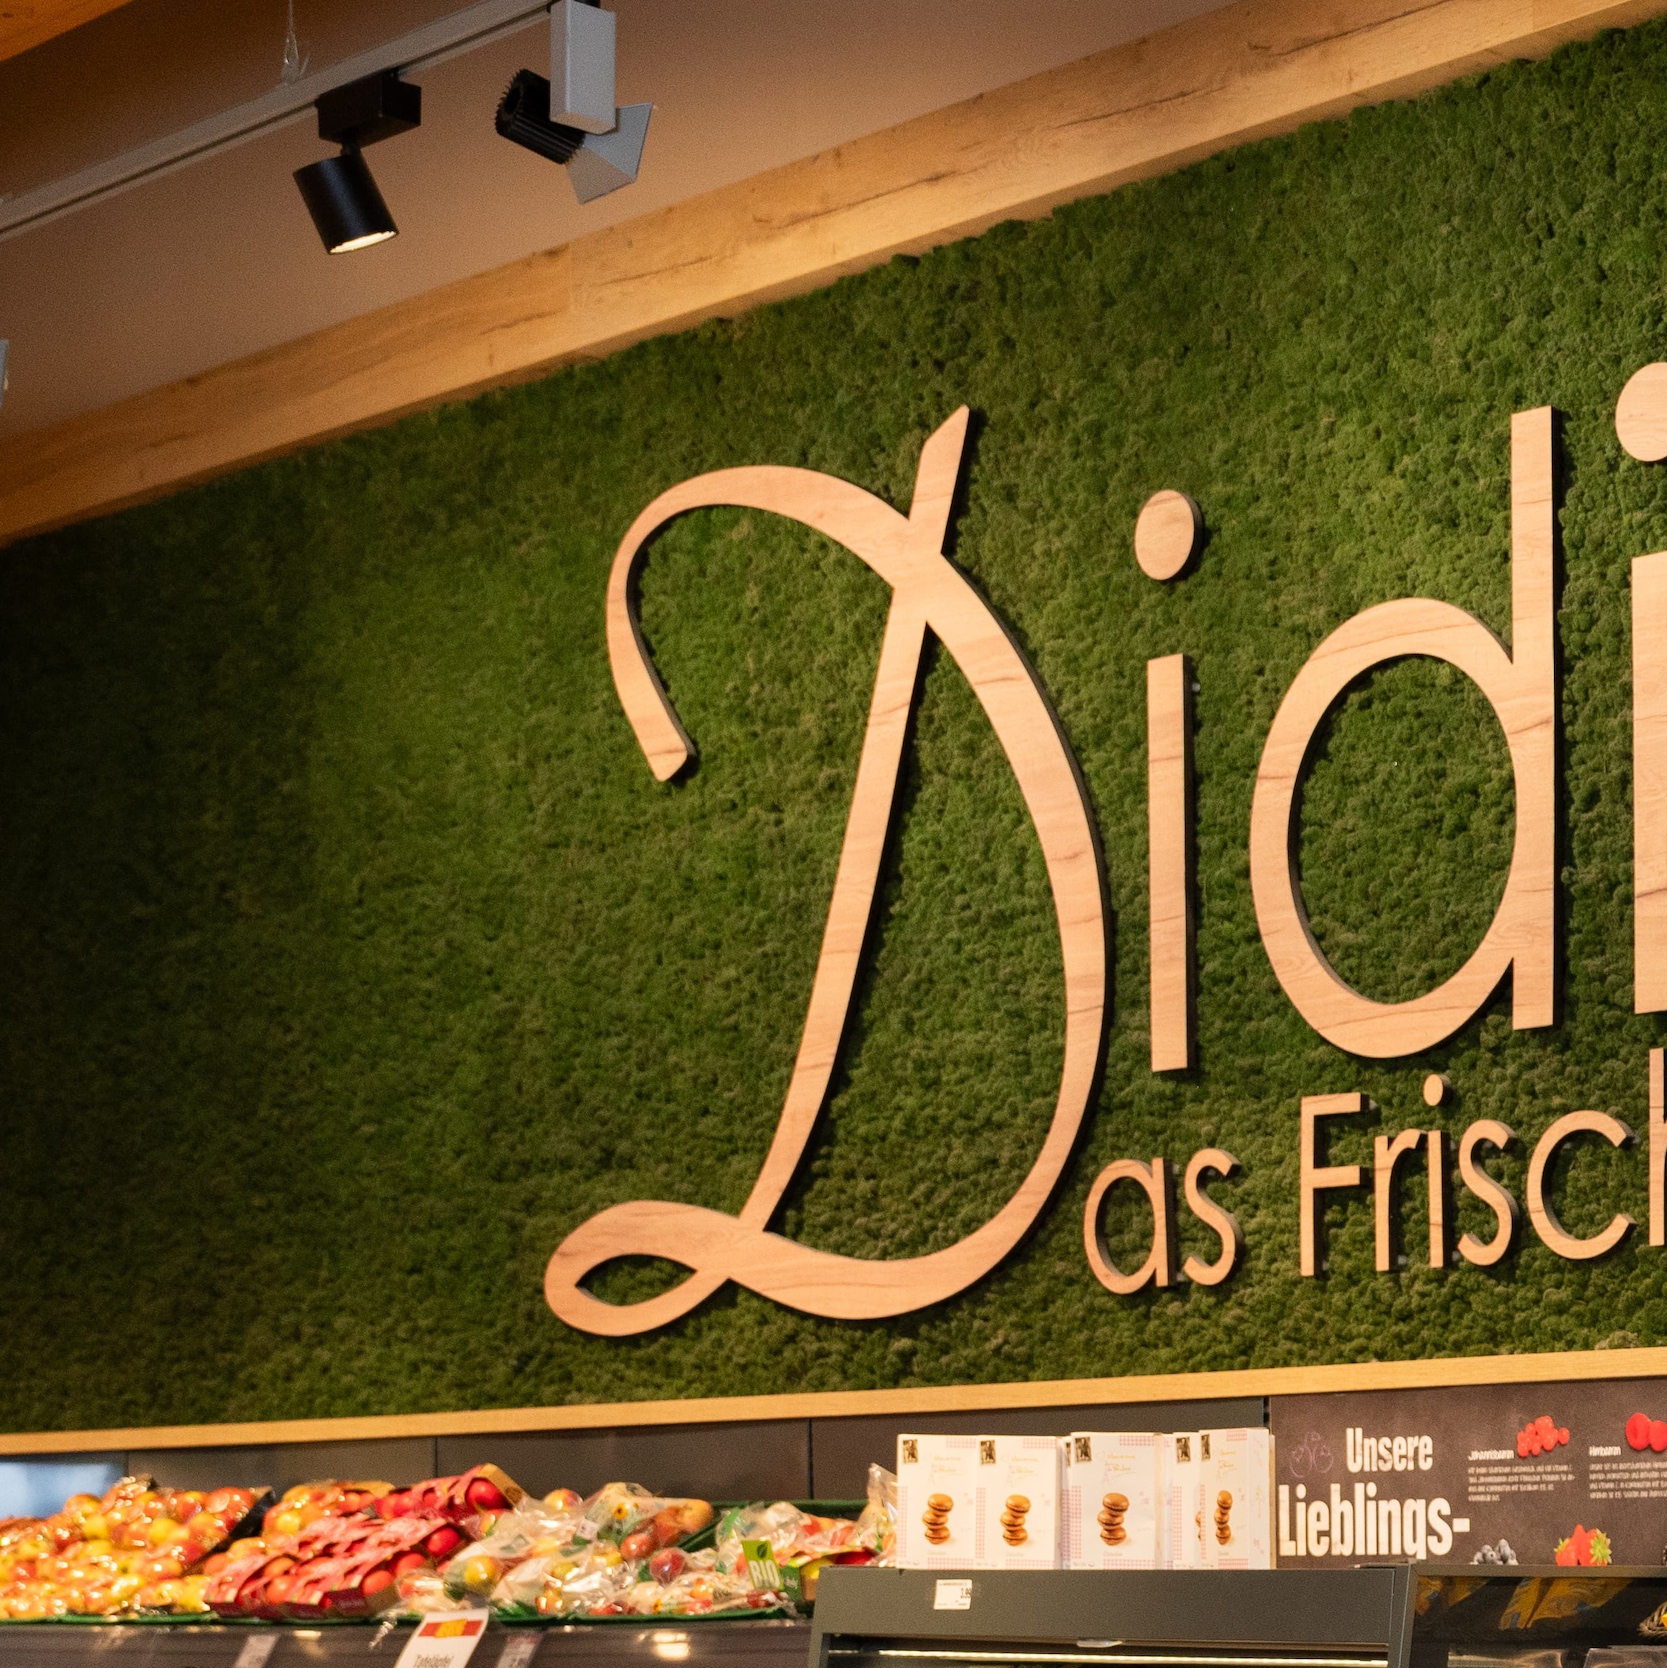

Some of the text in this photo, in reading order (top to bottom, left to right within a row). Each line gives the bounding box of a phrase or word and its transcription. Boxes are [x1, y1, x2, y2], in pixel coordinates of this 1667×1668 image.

[1346, 1427, 1433, 1472] Unsere
[1277, 1482, 1470, 1559] Lieblings-
[750, 1560, 780, 1590] BIO
